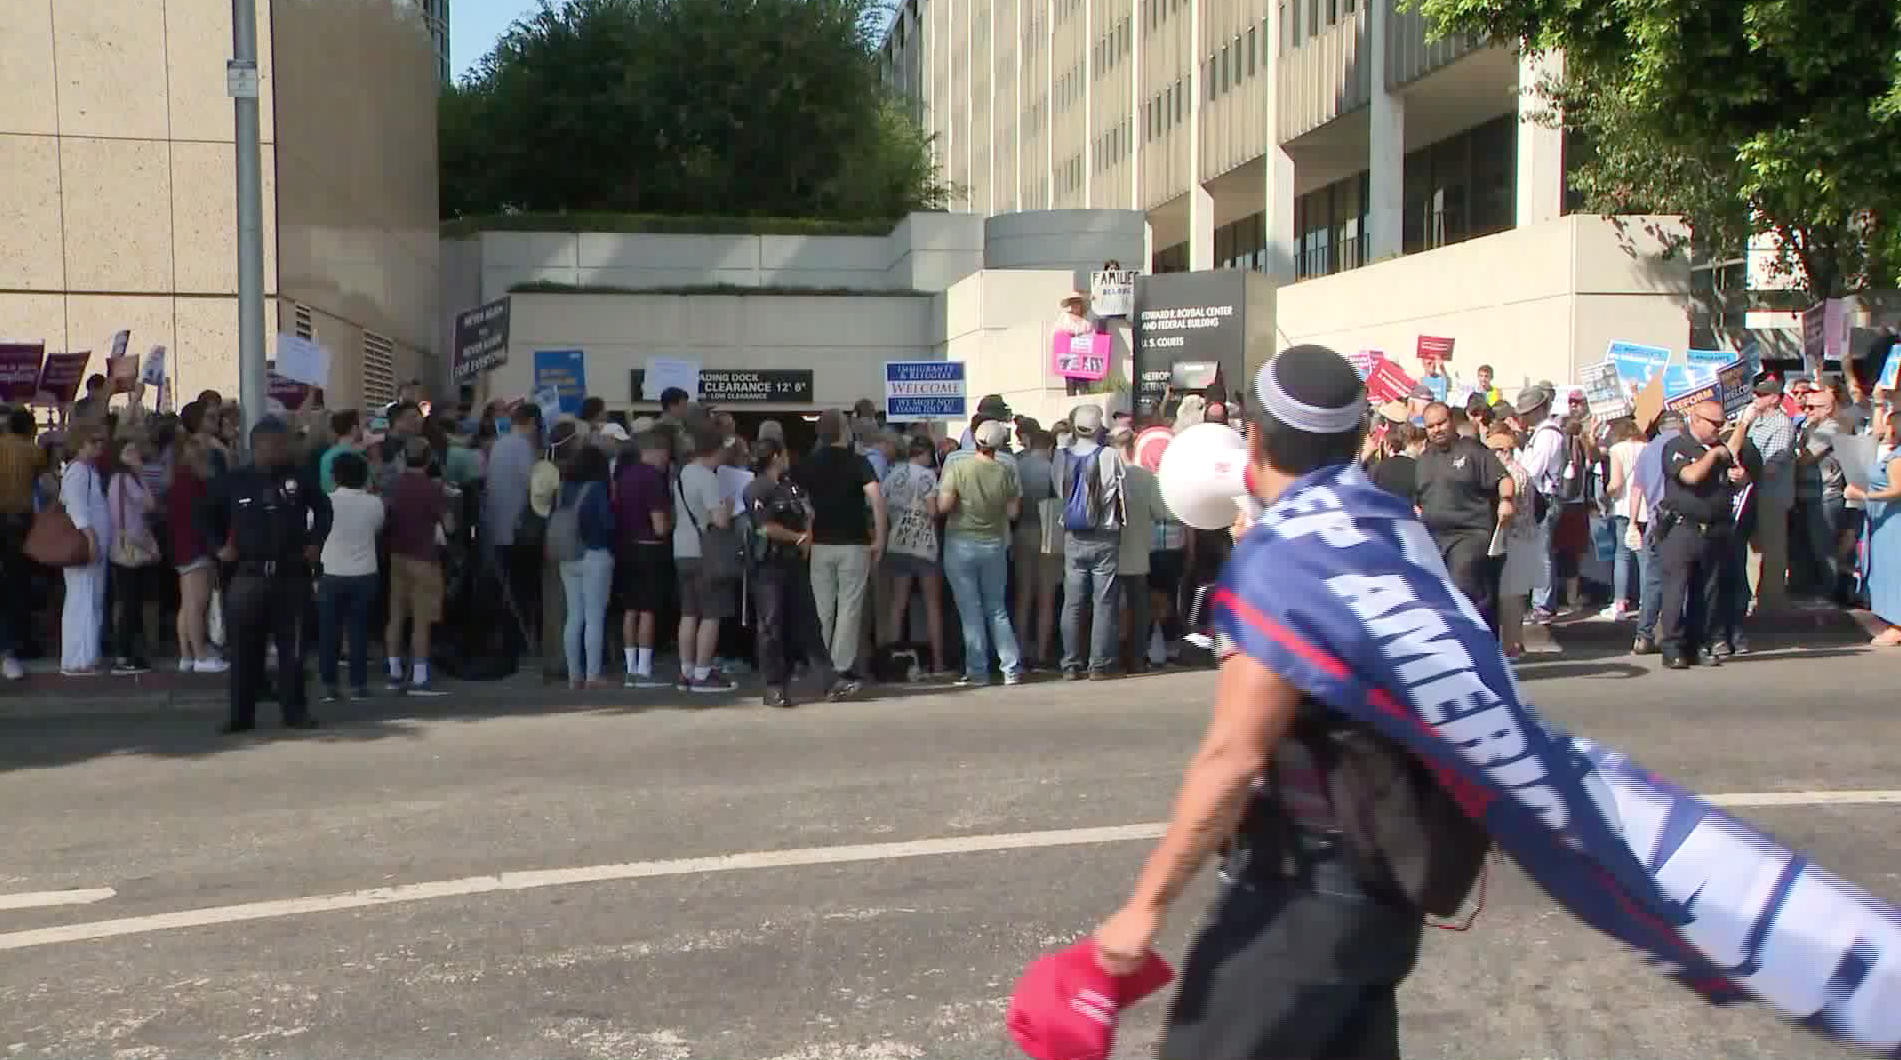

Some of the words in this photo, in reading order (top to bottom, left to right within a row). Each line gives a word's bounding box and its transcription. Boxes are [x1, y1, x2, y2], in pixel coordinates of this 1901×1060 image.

[1142, 311, 1169, 320] EDWARD
[1178, 307, 1205, 318] ROYBAL
[1206, 306, 1232, 316] CENTER
[1142, 320, 1157, 330] AND
[1158, 319, 1186, 330] FEDERAL
[1187, 317, 1219, 328] BUILDING
[1150, 338, 1156, 347] S.
[1157, 337, 1184, 347] COURTS
[700, 374, 729, 382] ADING
[732, 374, 758, 382] DOCK
[1142, 372, 1171, 382] METROP
[704, 383, 771, 393] CLEARANCE
[892, 382, 960, 394] WELCOME
[1670, 388, 1714, 411] REFORM
[1326, 573, 1583, 848] AMERIC
